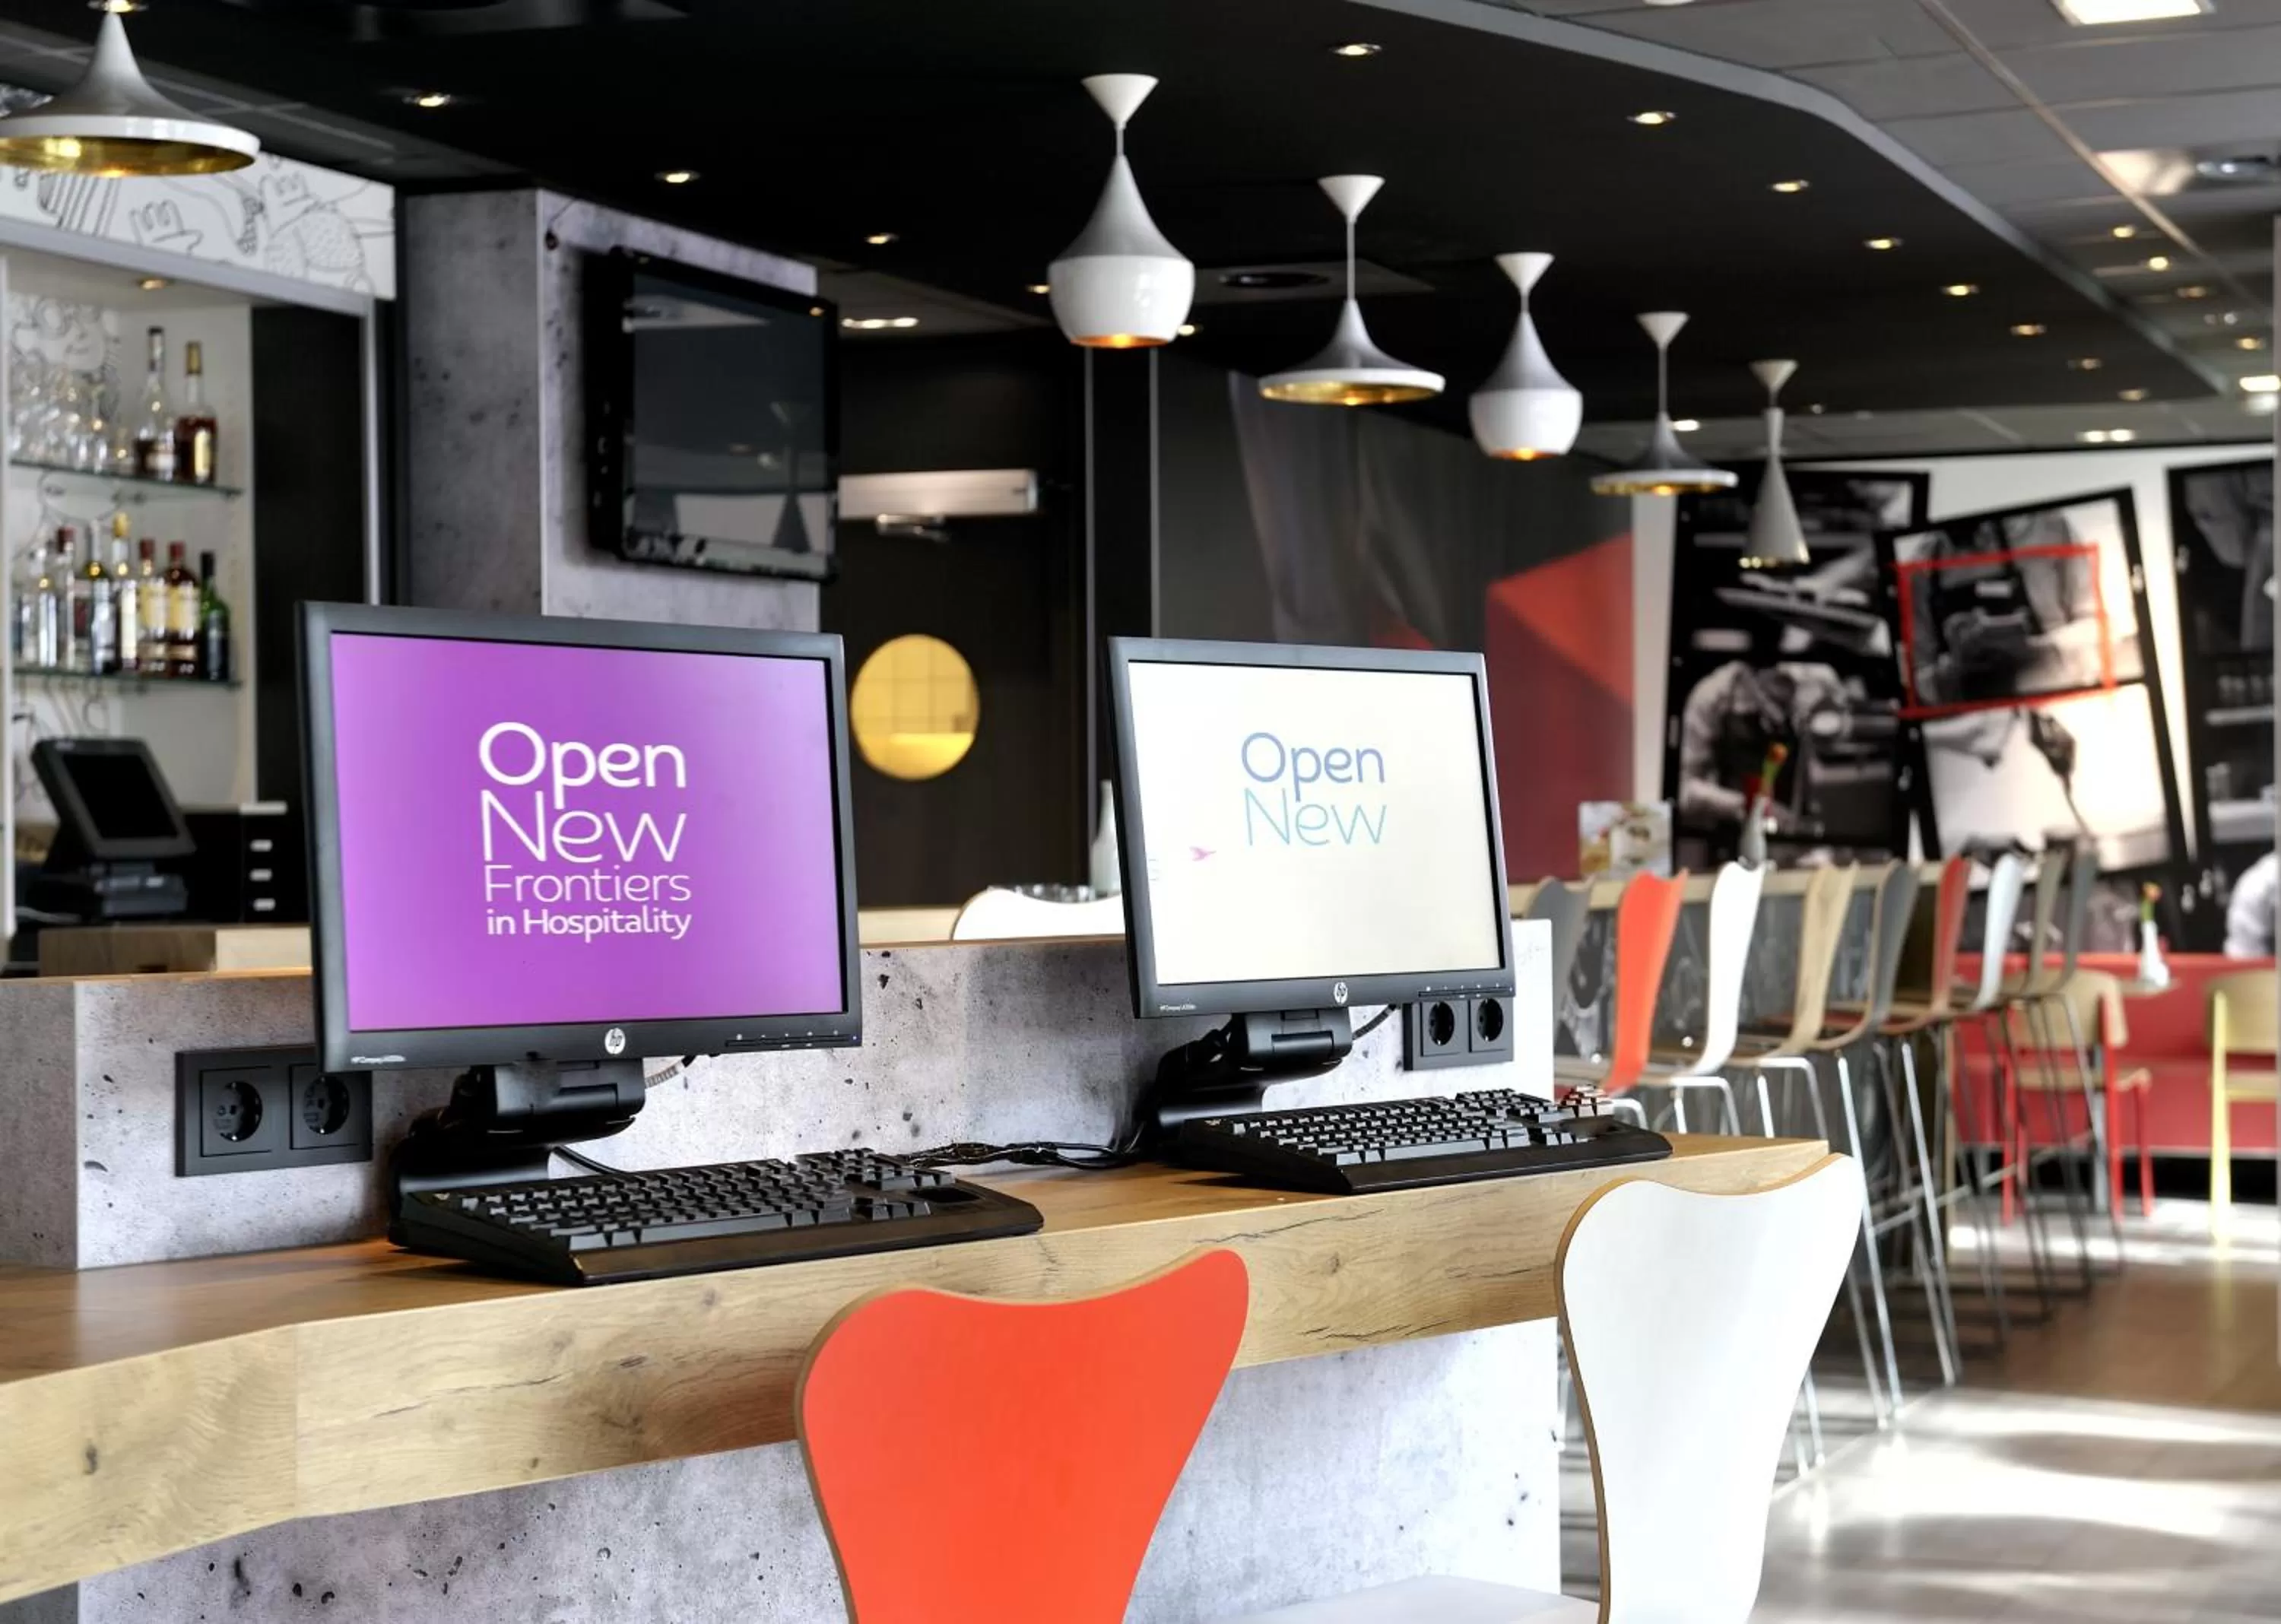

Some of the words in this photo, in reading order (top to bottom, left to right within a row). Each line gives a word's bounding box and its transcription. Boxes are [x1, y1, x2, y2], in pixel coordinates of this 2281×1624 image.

[479, 722, 687, 810] Open
[1241, 731, 1386, 804] Open
[481, 789, 687, 863] New
[1244, 787, 1388, 846] New
[484, 864, 691, 902] Frontiers
[487, 909, 516, 935] in
[523, 905, 692, 943] Hospitality
